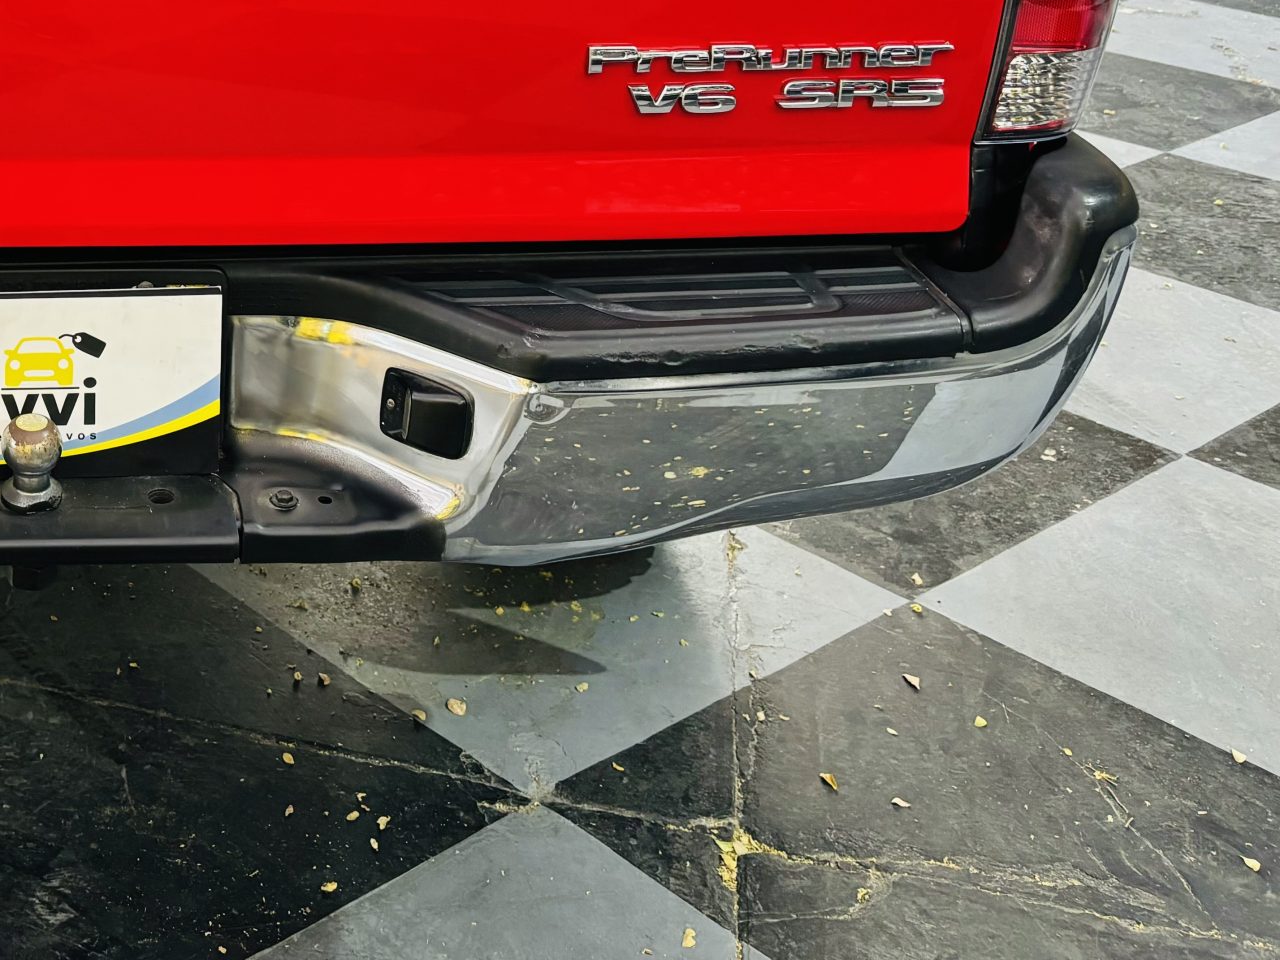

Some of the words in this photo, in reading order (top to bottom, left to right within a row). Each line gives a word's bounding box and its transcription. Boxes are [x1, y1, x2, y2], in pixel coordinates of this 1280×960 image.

[587, 42, 955, 74] PreRunner
[627, 82, 736, 115] V6
[775, 76, 945, 109] SR5
